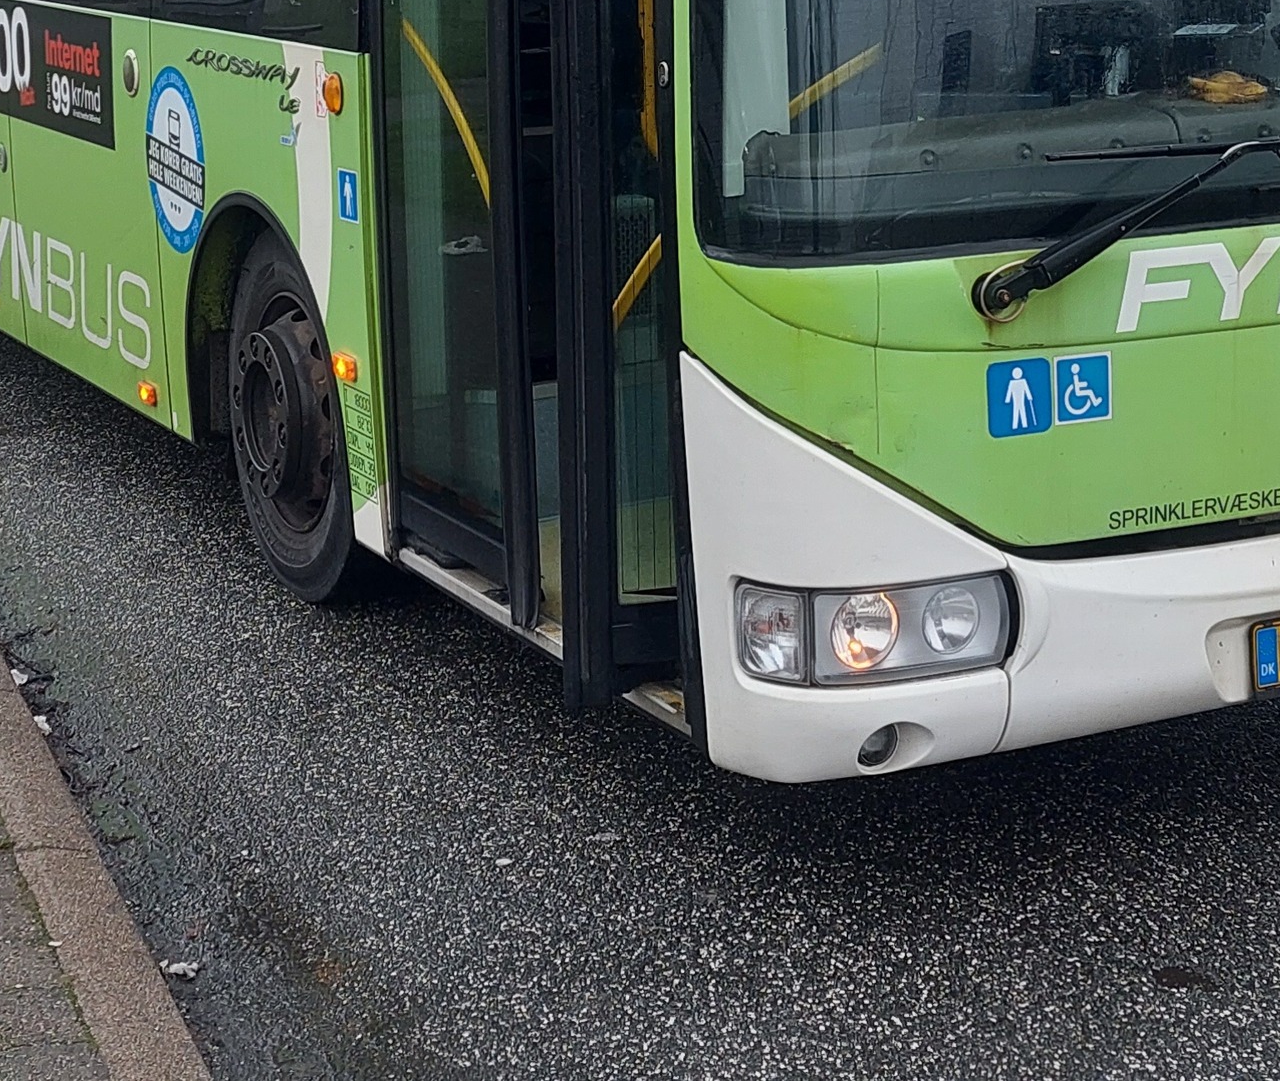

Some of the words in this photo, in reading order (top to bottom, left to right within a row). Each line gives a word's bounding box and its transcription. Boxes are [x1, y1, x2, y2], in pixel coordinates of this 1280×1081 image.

[44, 29, 100, 77] Internet
[186, 47, 301, 90] CROSSWAY
[51, 72, 70, 116] 99
[71, 79, 101, 112] kr/md
[278, 94, 301, 114] LE
[148, 138, 160, 160] JEG
[160, 144, 181, 172] KØRER
[181, 157, 203, 186] GRATIS
[148, 158, 163, 182] HELE
[163, 166, 203, 206] WEEKENDEN!
[1261, 662, 1276, 676] DK
